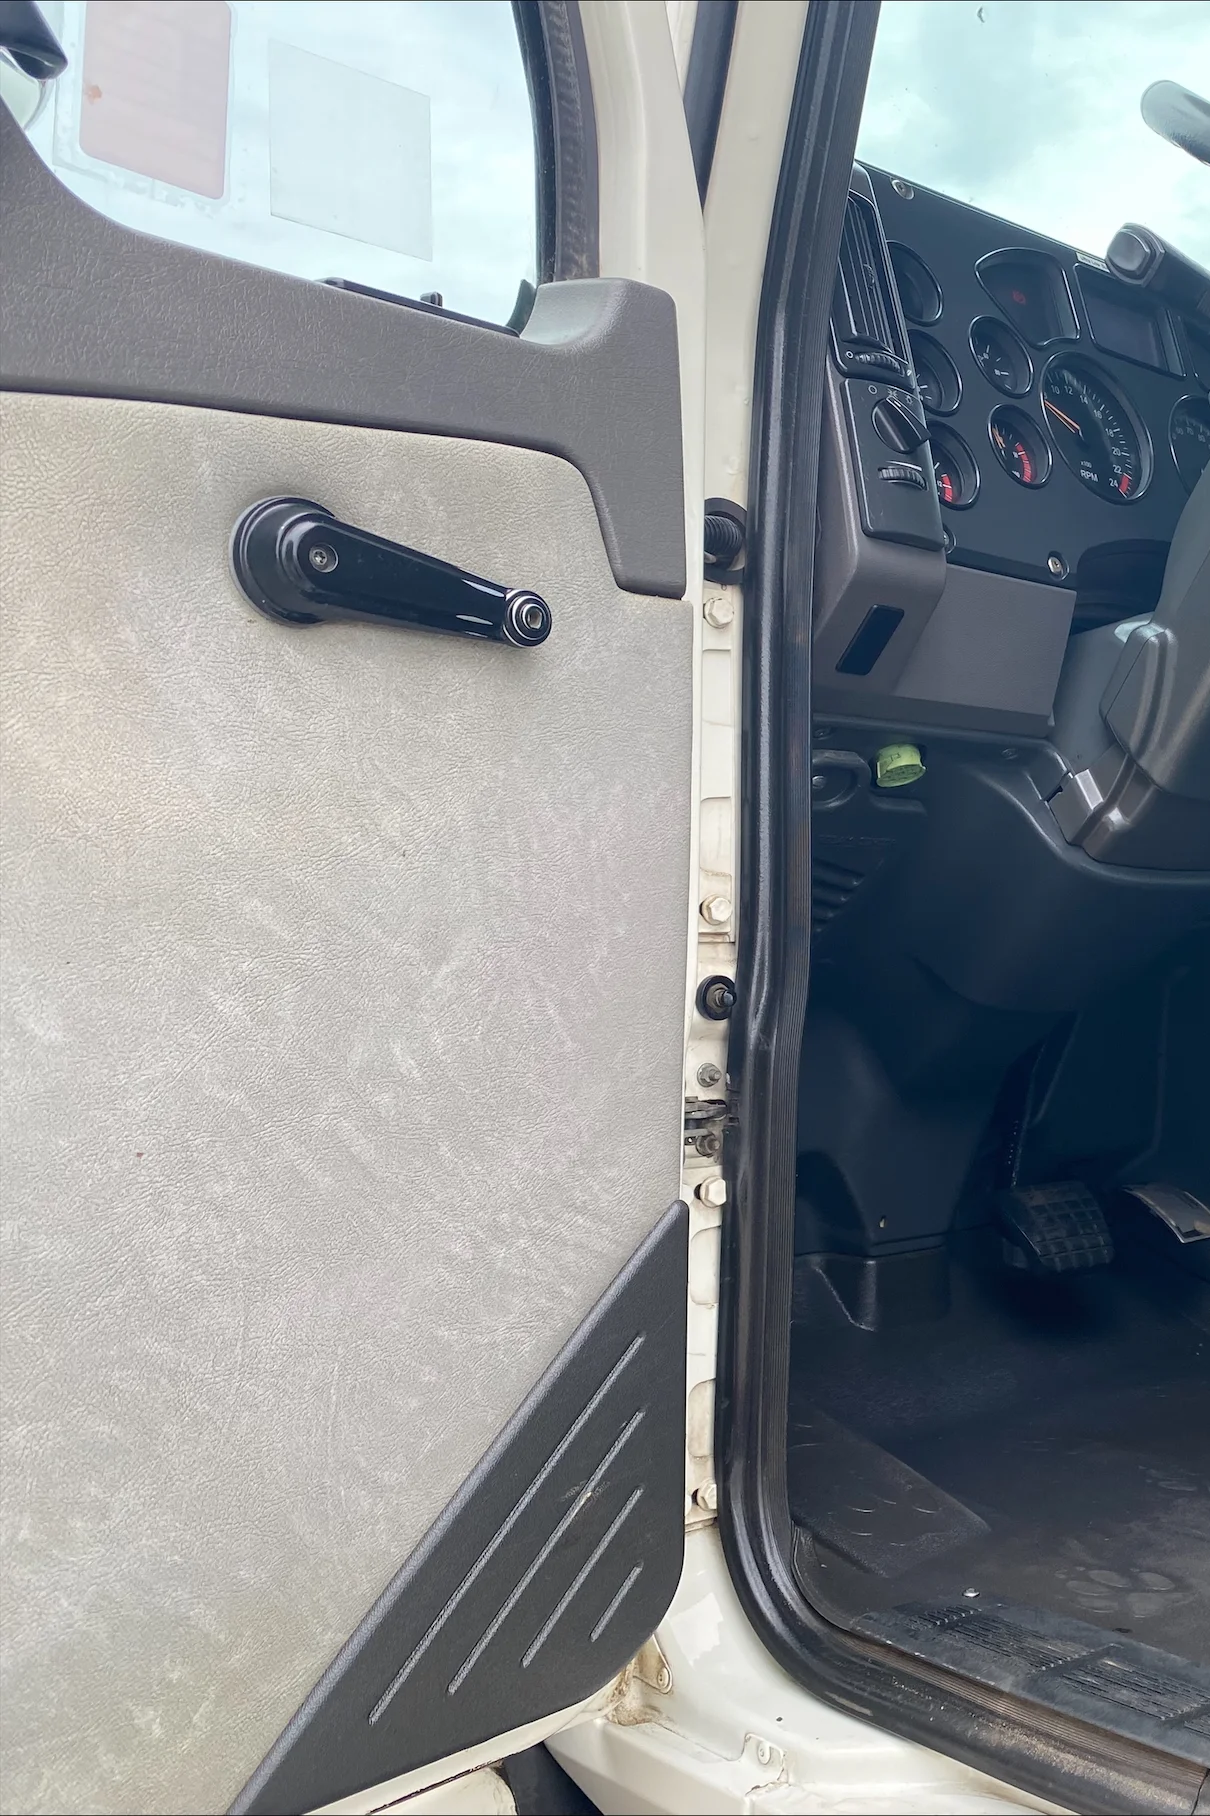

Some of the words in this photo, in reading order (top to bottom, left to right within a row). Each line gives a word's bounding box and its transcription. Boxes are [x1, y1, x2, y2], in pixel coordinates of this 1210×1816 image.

[1064, 386, 1073, 395] 12
[1080, 395, 1088, 404] 14
[1112, 447, 1121, 456] 20
[1113, 465, 1122, 474] 22
[1080, 469, 1099, 482] RPM
[1109, 478, 1118, 487] 24
